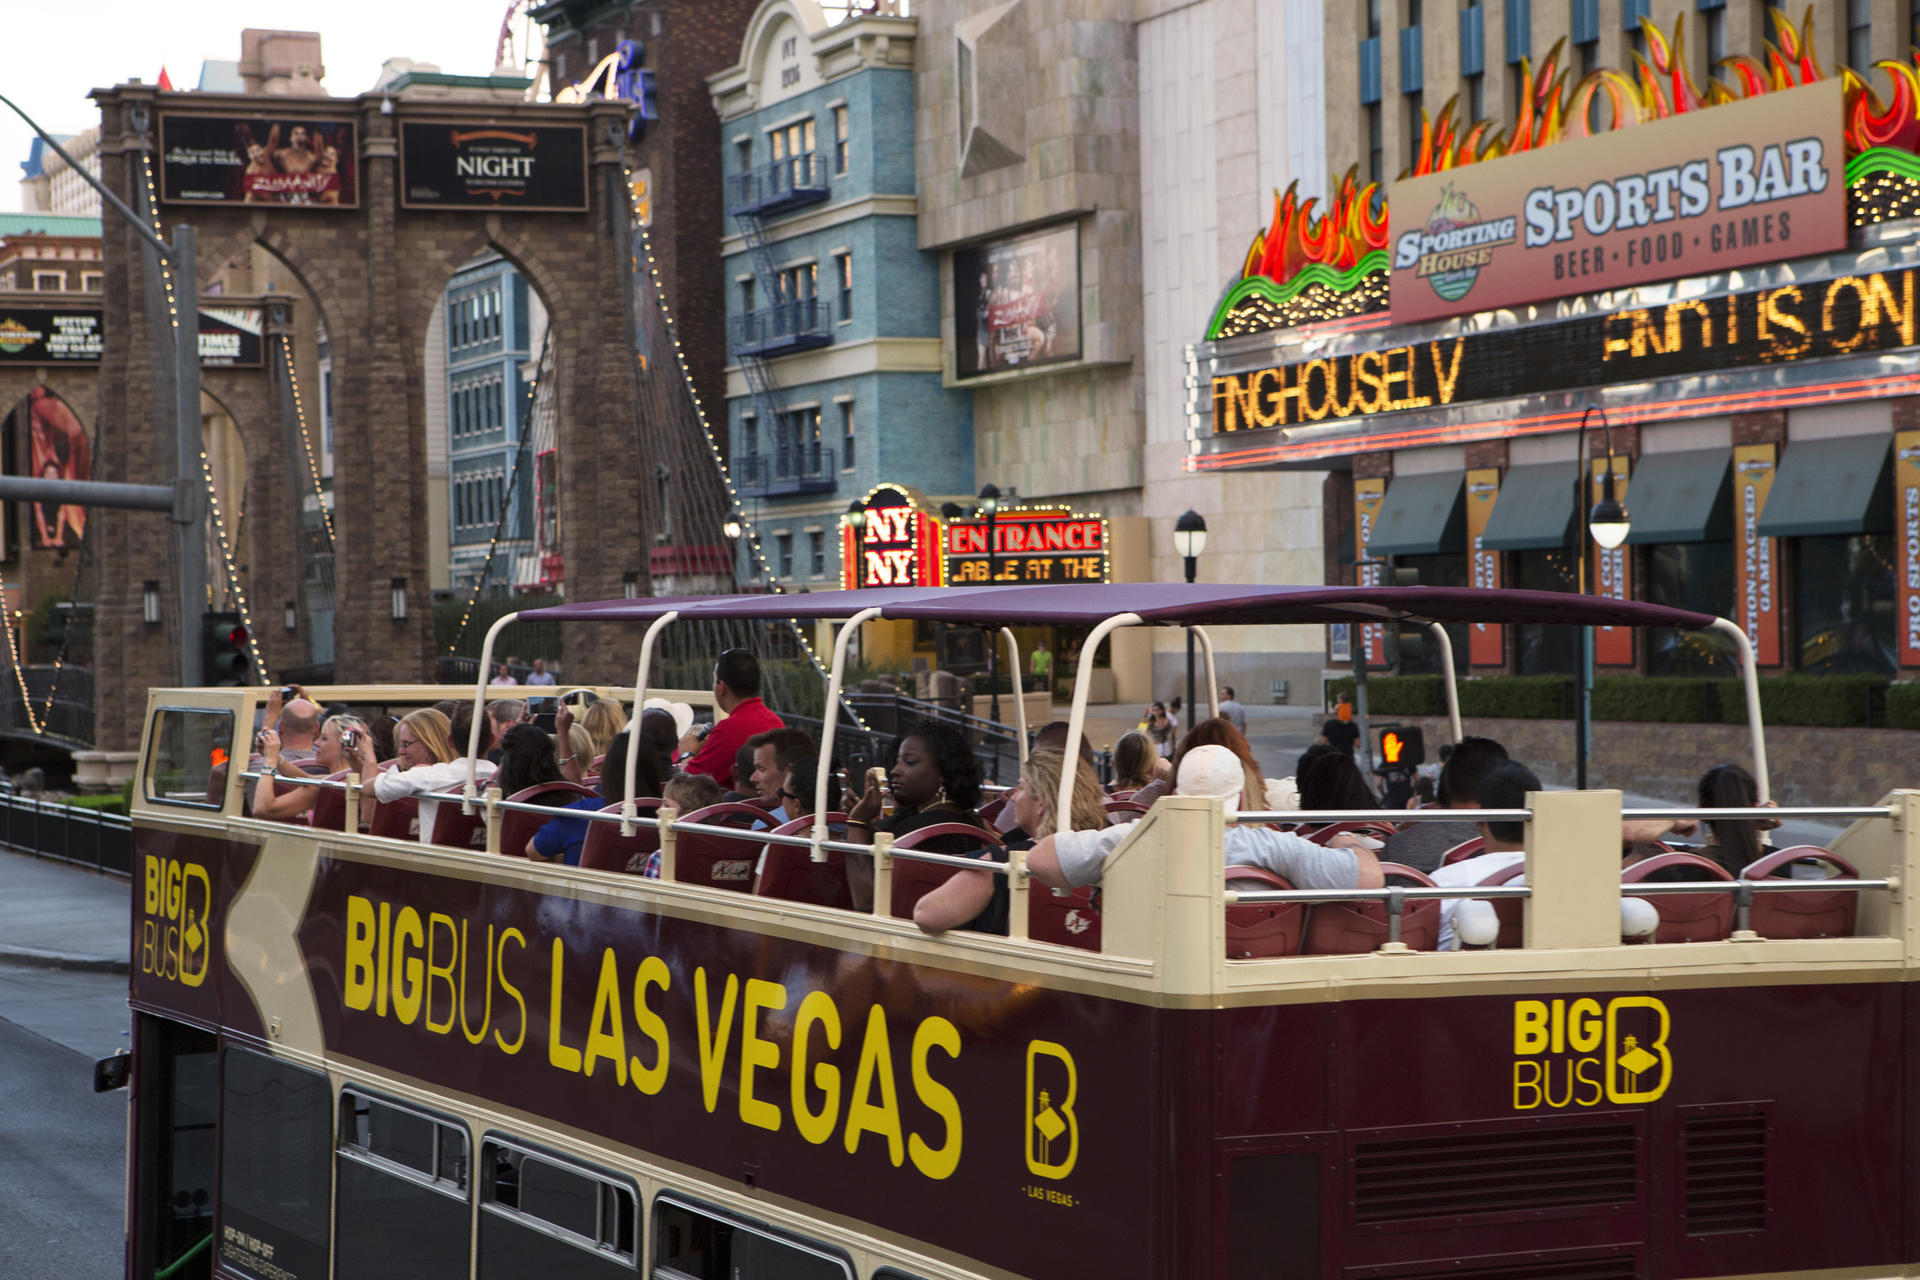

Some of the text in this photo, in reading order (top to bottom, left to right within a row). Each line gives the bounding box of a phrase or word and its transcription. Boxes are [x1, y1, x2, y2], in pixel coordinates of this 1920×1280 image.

[456, 156, 536, 177] NIGHT
[1525, 137, 1828, 247] SPORTS BAR
[1394, 215, 1516, 270] SPORTING
[1417, 248, 1491, 277] HOUSE
[1554, 212, 1791, 280] BEER FOOD GAMES
[864, 507, 913, 543] NY
[950, 521, 1103, 553] ENTRANCE
[864, 550, 914, 586] NY
[1025, 559, 1053, 580] AT
[1060, 557, 1102, 579] THE
[1758, 536, 1771, 613] GAMES
[1906, 486, 1920, 650] PRO SPORTS
[145, 854, 181, 921] BIG
[142, 920, 178, 981] BUS
[1513, 997, 1604, 1056] BIG
[548, 937, 672, 1096] LAS
[694, 966, 964, 1180] VEGAS
[1513, 1057, 1603, 1110] BUS
[1028, 1185, 1073, 1207] LAS VEGAS
